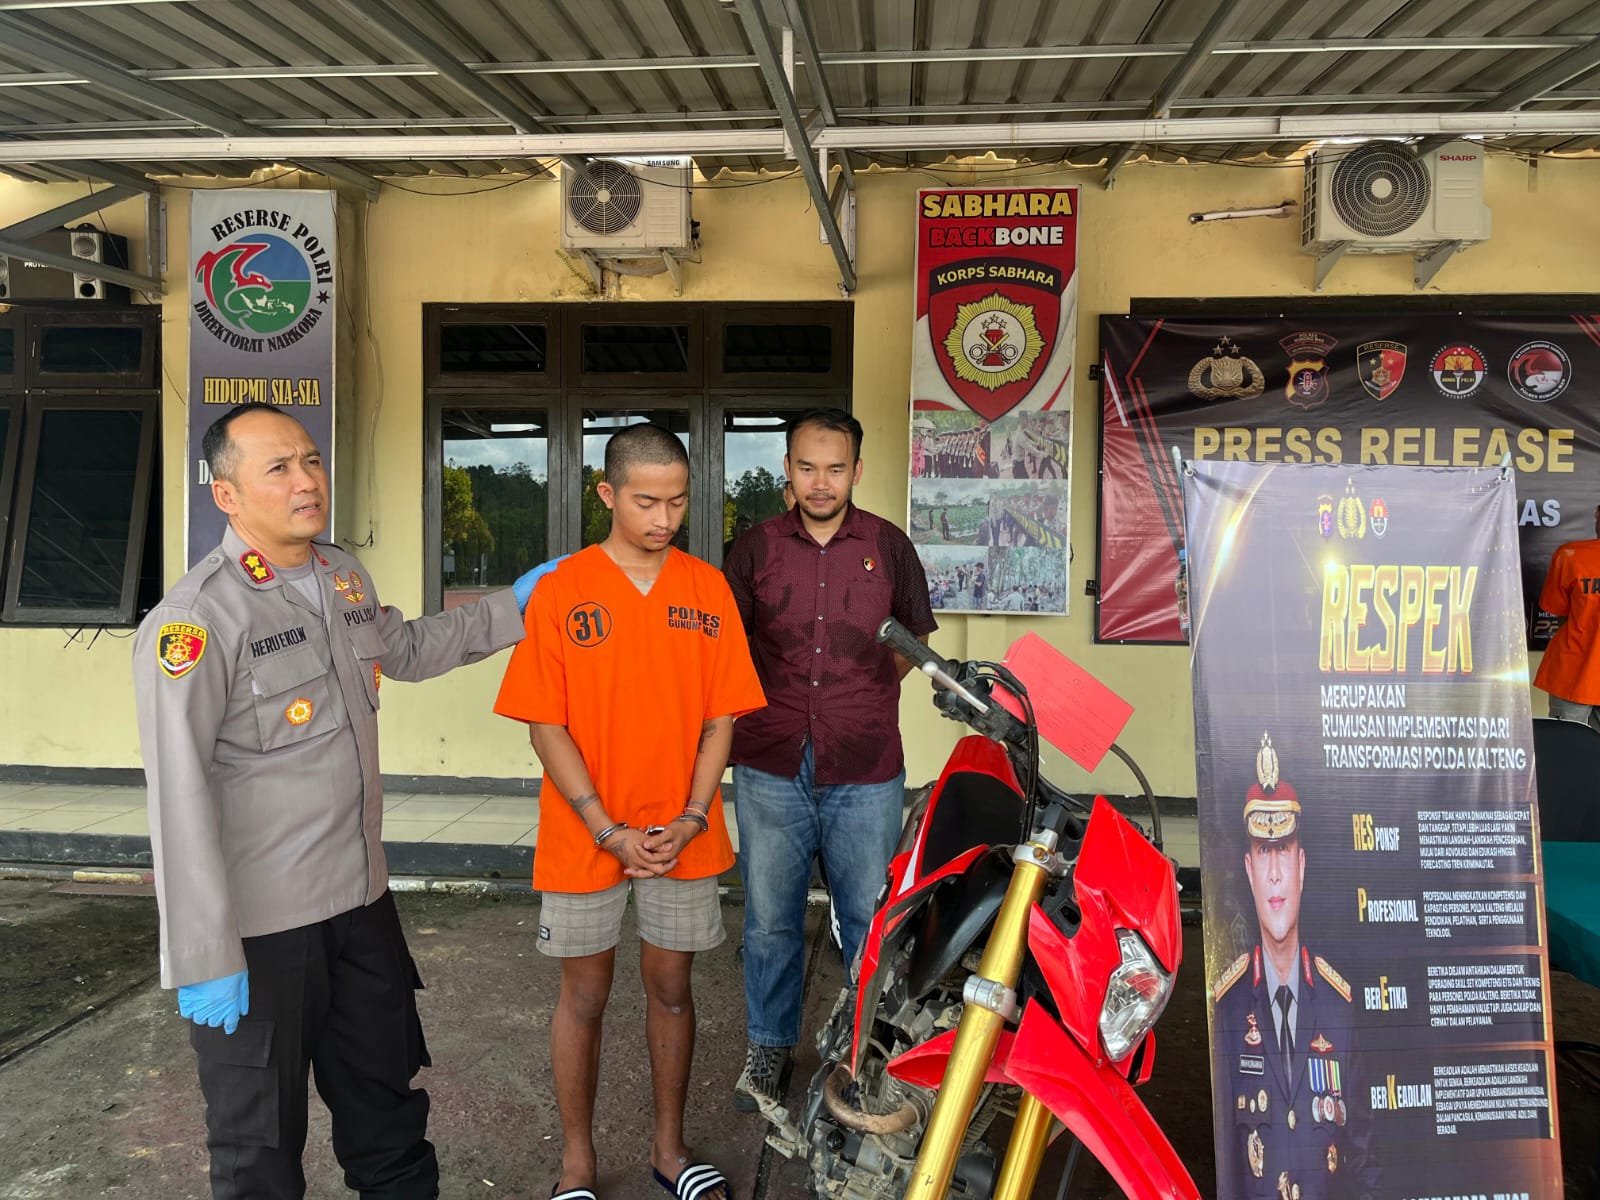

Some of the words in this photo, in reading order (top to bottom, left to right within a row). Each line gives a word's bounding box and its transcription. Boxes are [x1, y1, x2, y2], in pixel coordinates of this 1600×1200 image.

[923, 192, 1072, 217] SABHARA
[210, 209, 291, 242] RESERSE
[292, 222, 333, 284] POLRI
[929, 226, 1063, 247] BACKBONE
[937, 266, 985, 286] KORPS
[988, 266, 1054, 287] SABHARA
[194, 300, 265, 352] DIREKTORAT
[267, 308, 323, 352] NARKOBA
[203, 378, 268, 404] HIDUPMU
[271, 378, 321, 406] SIA-SIA
[1193, 427, 1343, 465] PRESS
[1360, 428, 1575, 473] RELEASE
[1517, 499, 1561, 527] AS
[573, 608, 605, 642] 31
[668, 606, 721, 629] POLRES
[1319, 564, 1479, 674] RESPEK
[703, 626, 719, 639] MAS
[1321, 685, 1406, 708] MERUPAKAN
[1322, 715, 1385, 738] RUMUSAN
[1388, 716, 1478, 739] IMPLEMENTASI
[1479, 717, 1510, 739] DARI
[1324, 745, 1422, 769] TRANSFORMASI
[1424, 747, 1466, 770] POLDA
[1467, 748, 1527, 770] KALTENG
